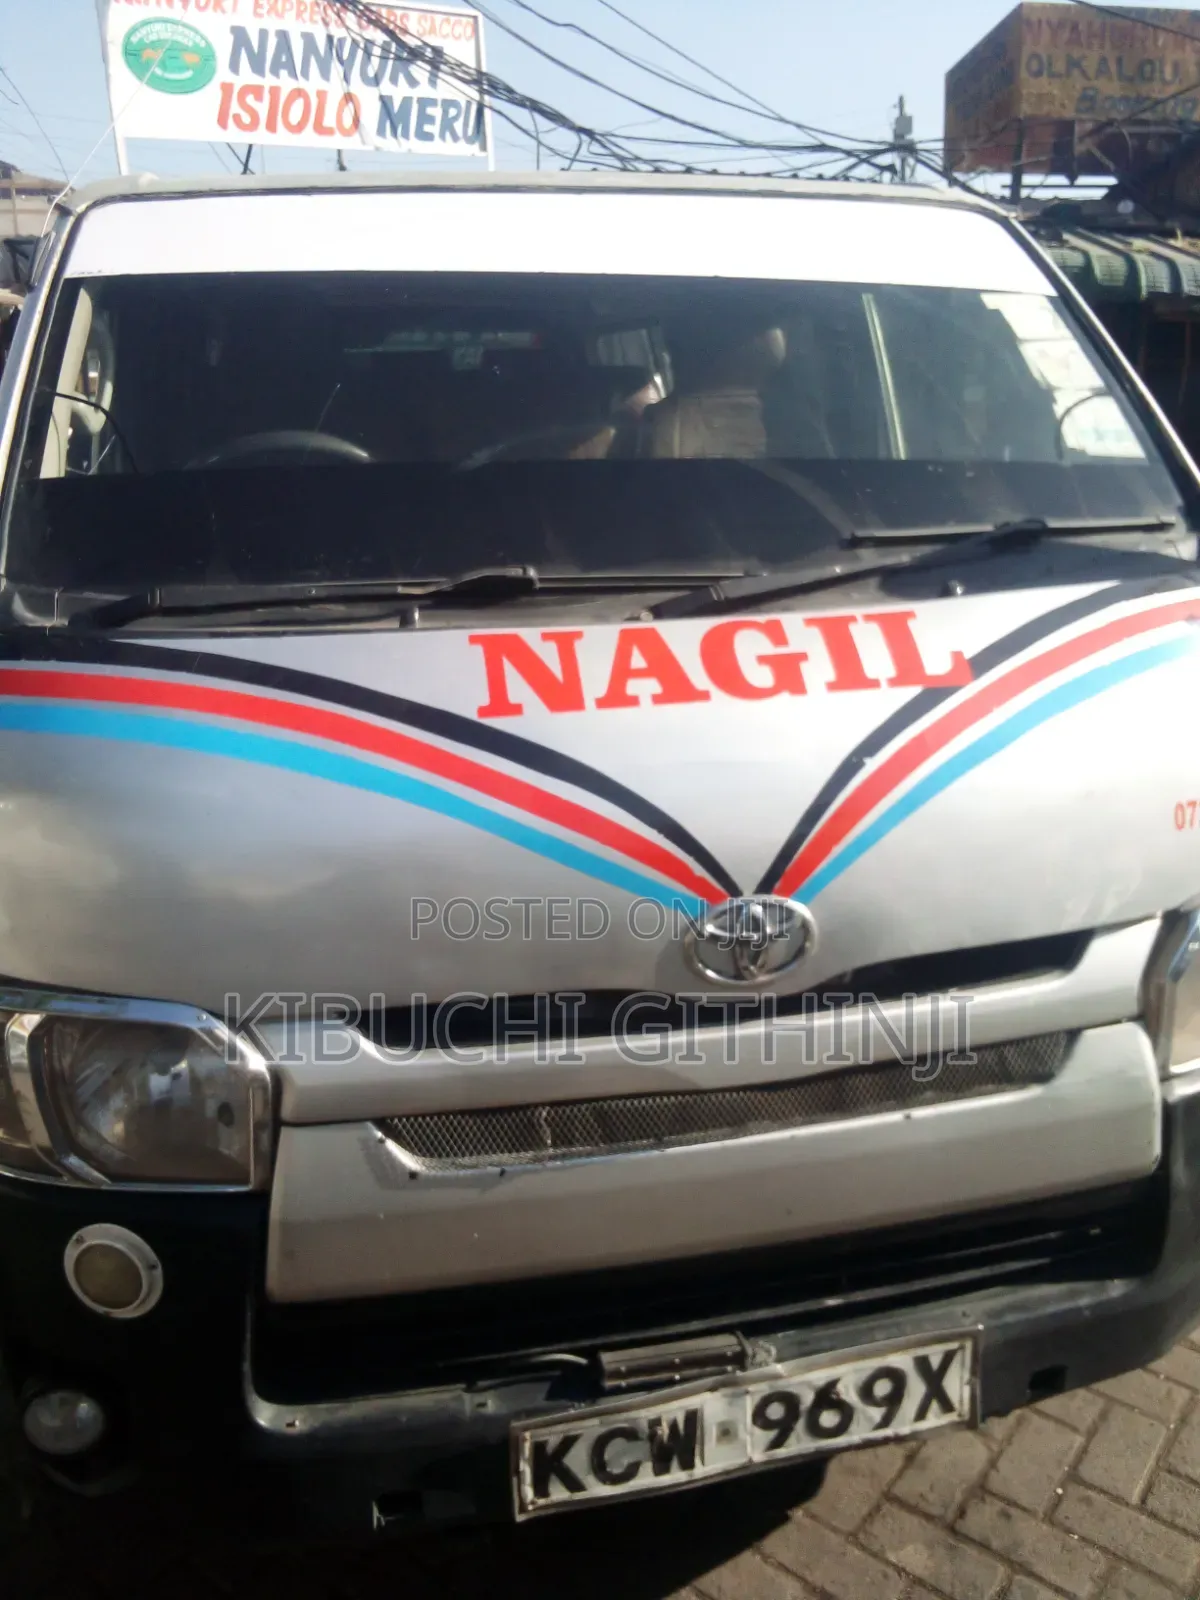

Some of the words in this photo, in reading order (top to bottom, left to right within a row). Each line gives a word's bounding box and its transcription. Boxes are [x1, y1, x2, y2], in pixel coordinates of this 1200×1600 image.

[228, 25, 444, 91] NANYUKI
[416, 13, 476, 41] SACCO
[217, 81, 361, 138] ISIOLO
[376, 94, 485, 146] MERU
[468, 610, 975, 719] NAGIL
[1174, 800, 1200, 831] 07
[533, 1408, 700, 1500] KCW
[751, 1349, 958, 1452] 969X
